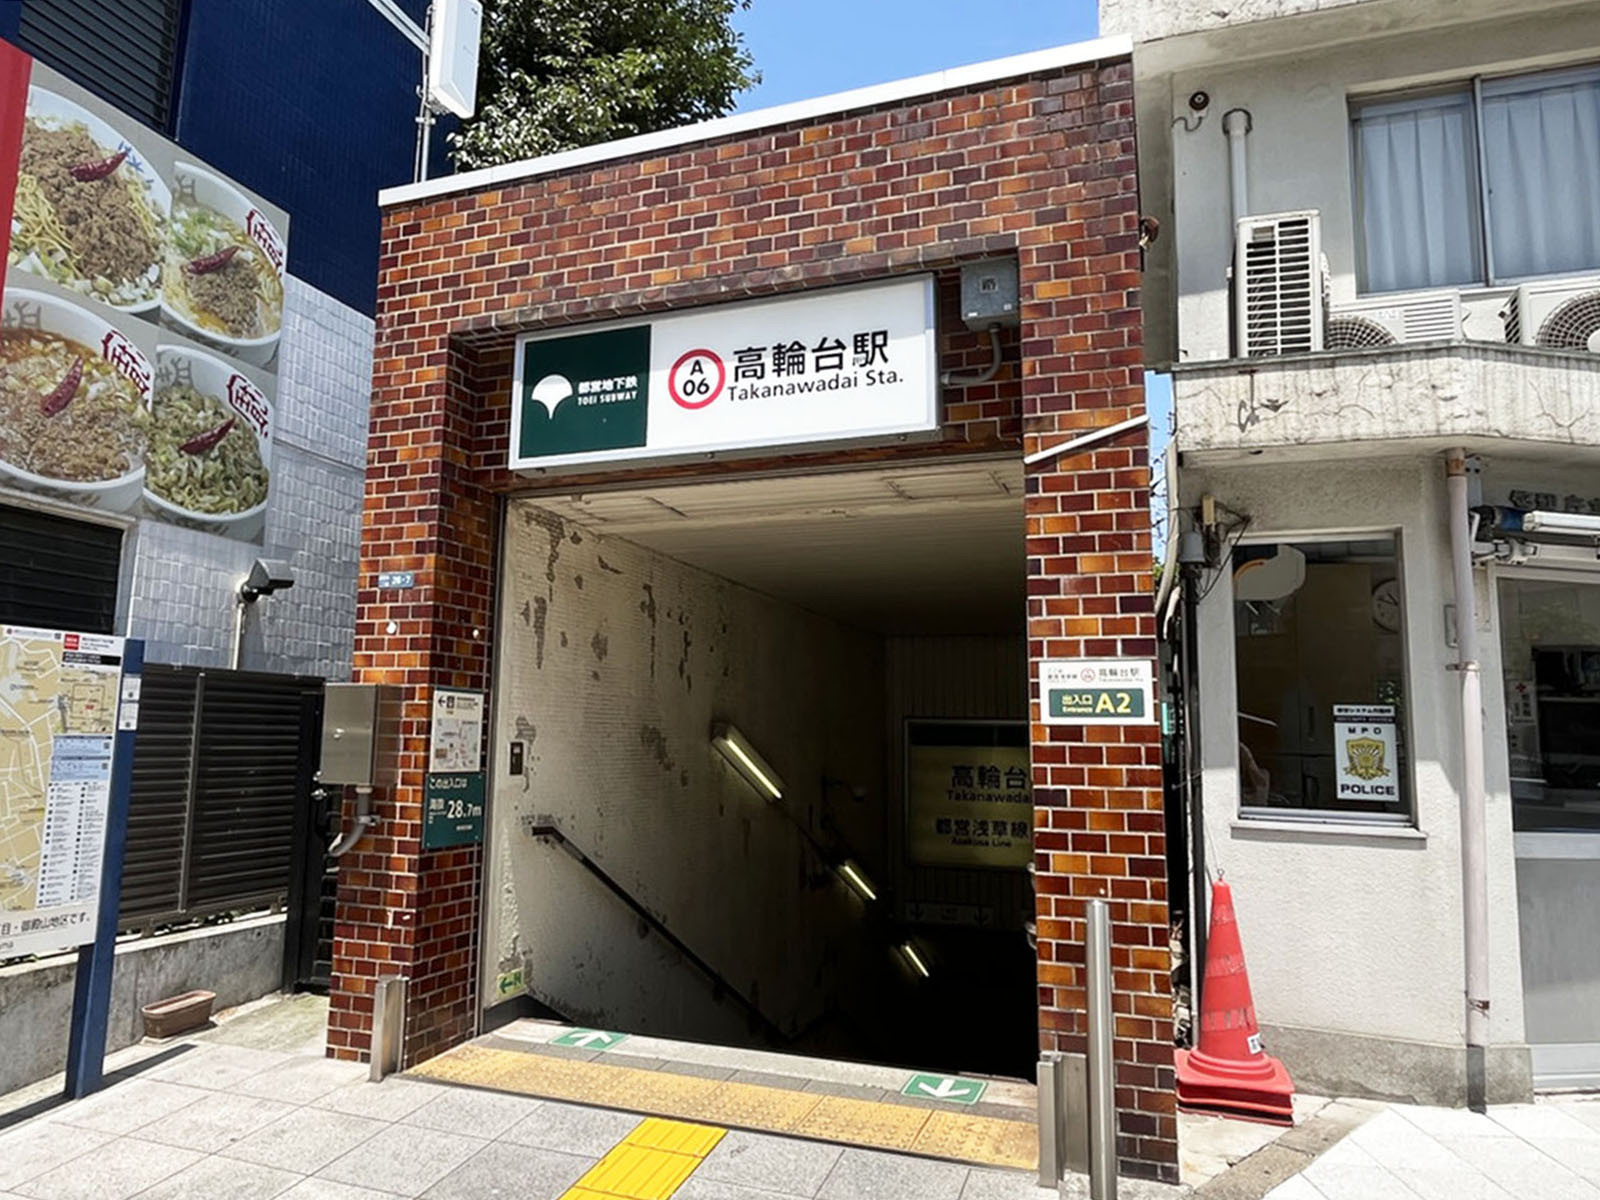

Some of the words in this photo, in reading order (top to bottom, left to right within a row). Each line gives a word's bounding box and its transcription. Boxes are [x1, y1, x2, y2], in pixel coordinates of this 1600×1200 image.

[733, 329, 889, 383] 高輪台駅
[690, 359, 704, 376] A
[683, 378, 710, 397] 06
[728, 371, 858, 401] Takanawadai
[866, 369, 904, 387] Sta.
[577, 396, 598, 406] TOEI
[600, 391, 638, 404] SUBWAY
[1062, 694, 1093, 705] 出入口
[1095, 692, 1132, 714] A2
[951, 765, 1028, 789] 高輪台
[1340, 784, 1396, 795] POLICE
[447, 800, 482, 819] 28.7m
